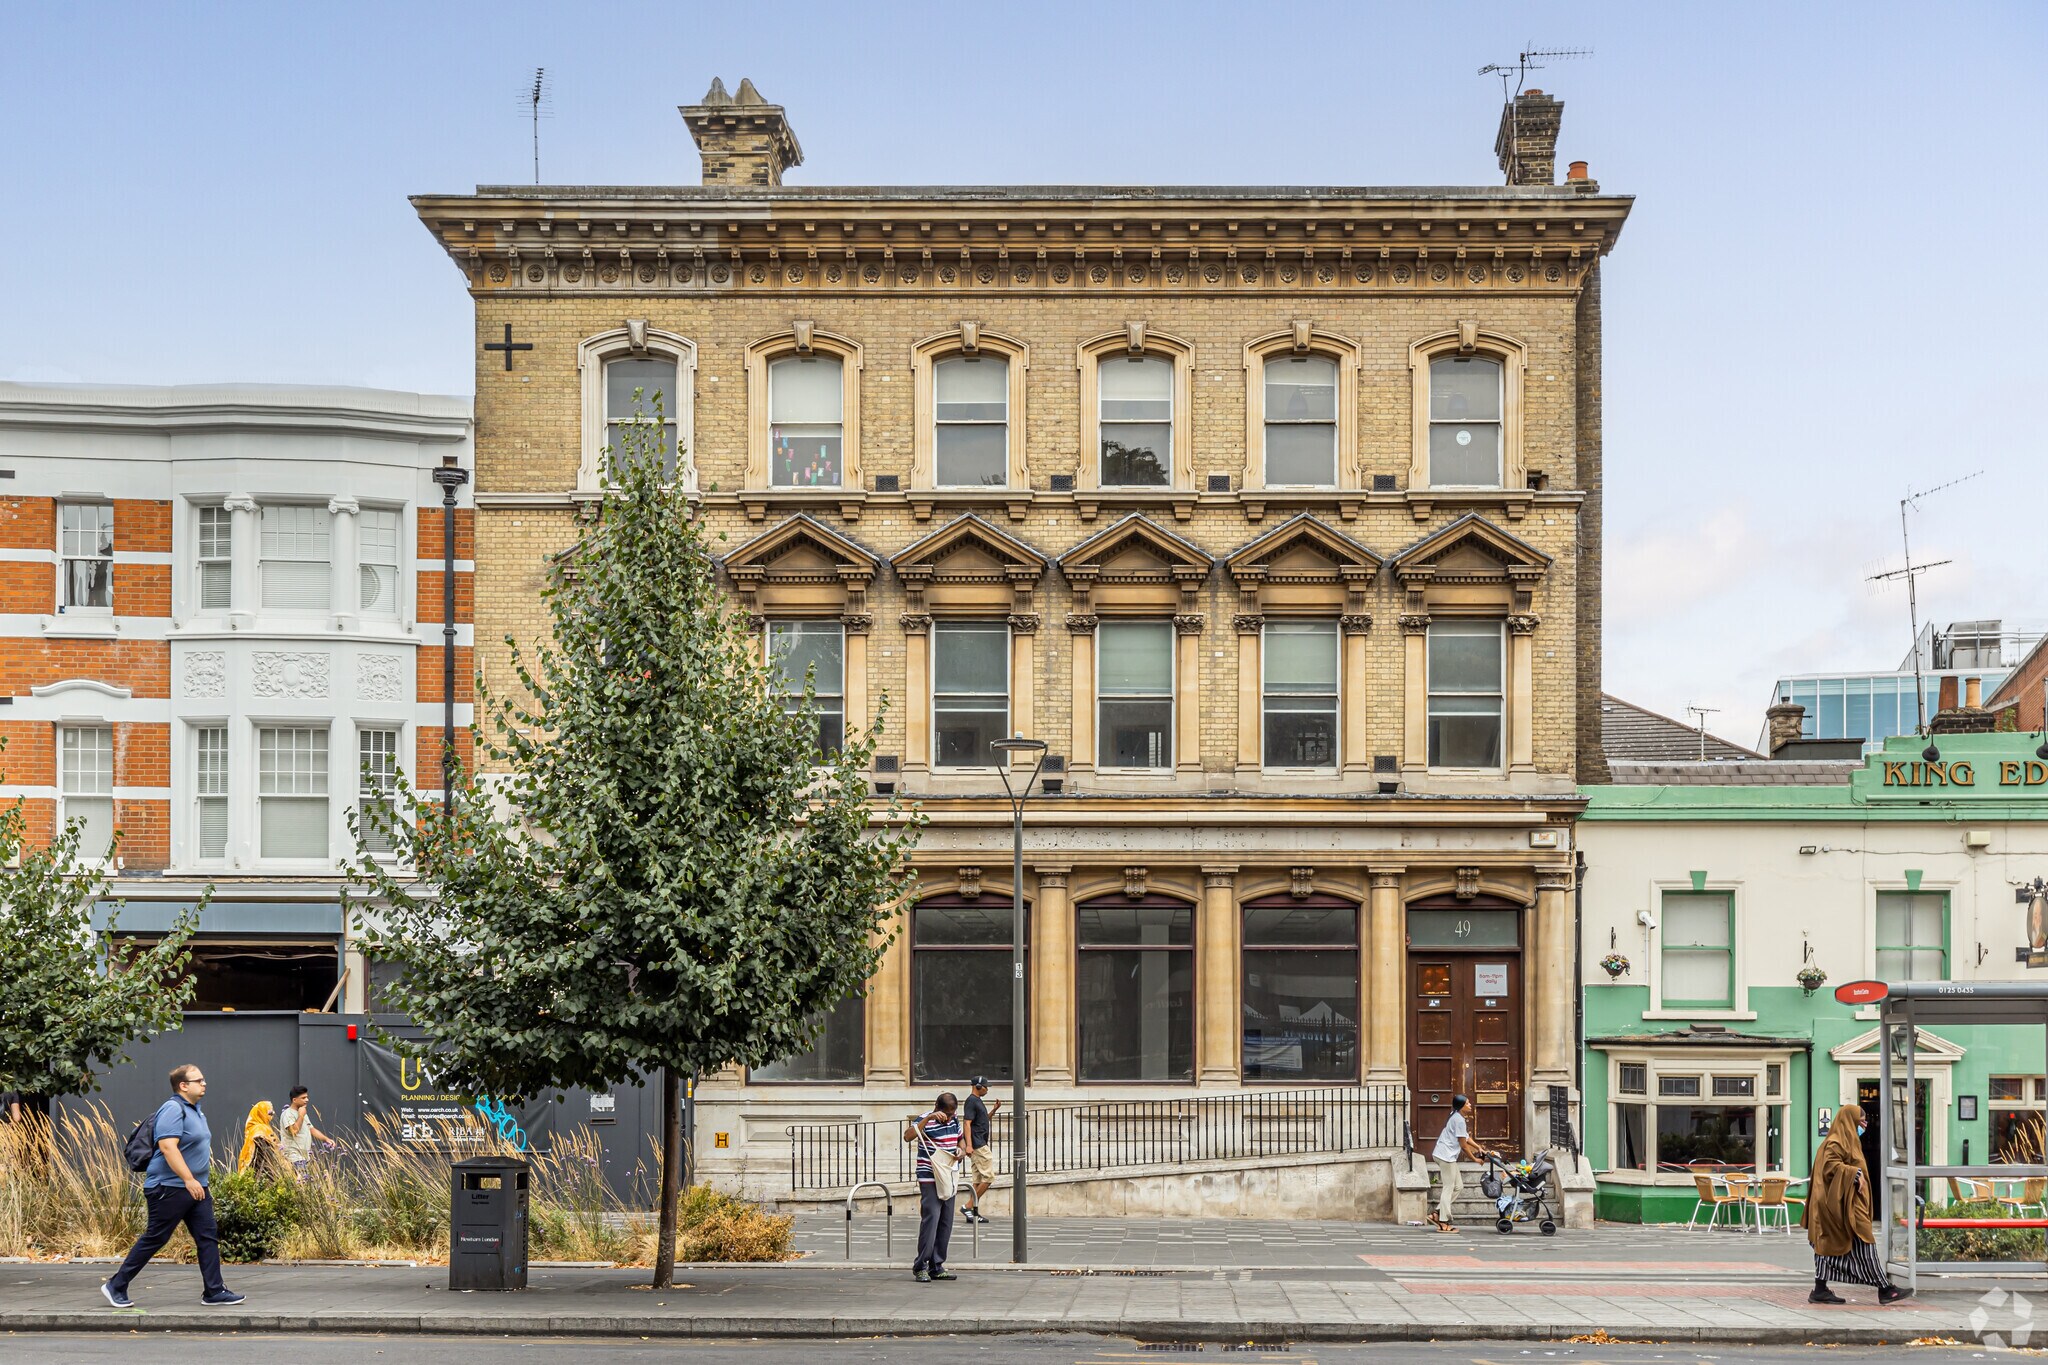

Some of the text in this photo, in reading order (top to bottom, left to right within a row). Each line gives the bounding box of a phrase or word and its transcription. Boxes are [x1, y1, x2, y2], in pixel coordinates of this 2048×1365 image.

[1883, 761, 1975, 786] KING
[1454, 920, 1471, 937] 49
[1938, 986, 1974, 994] 0125 0435
